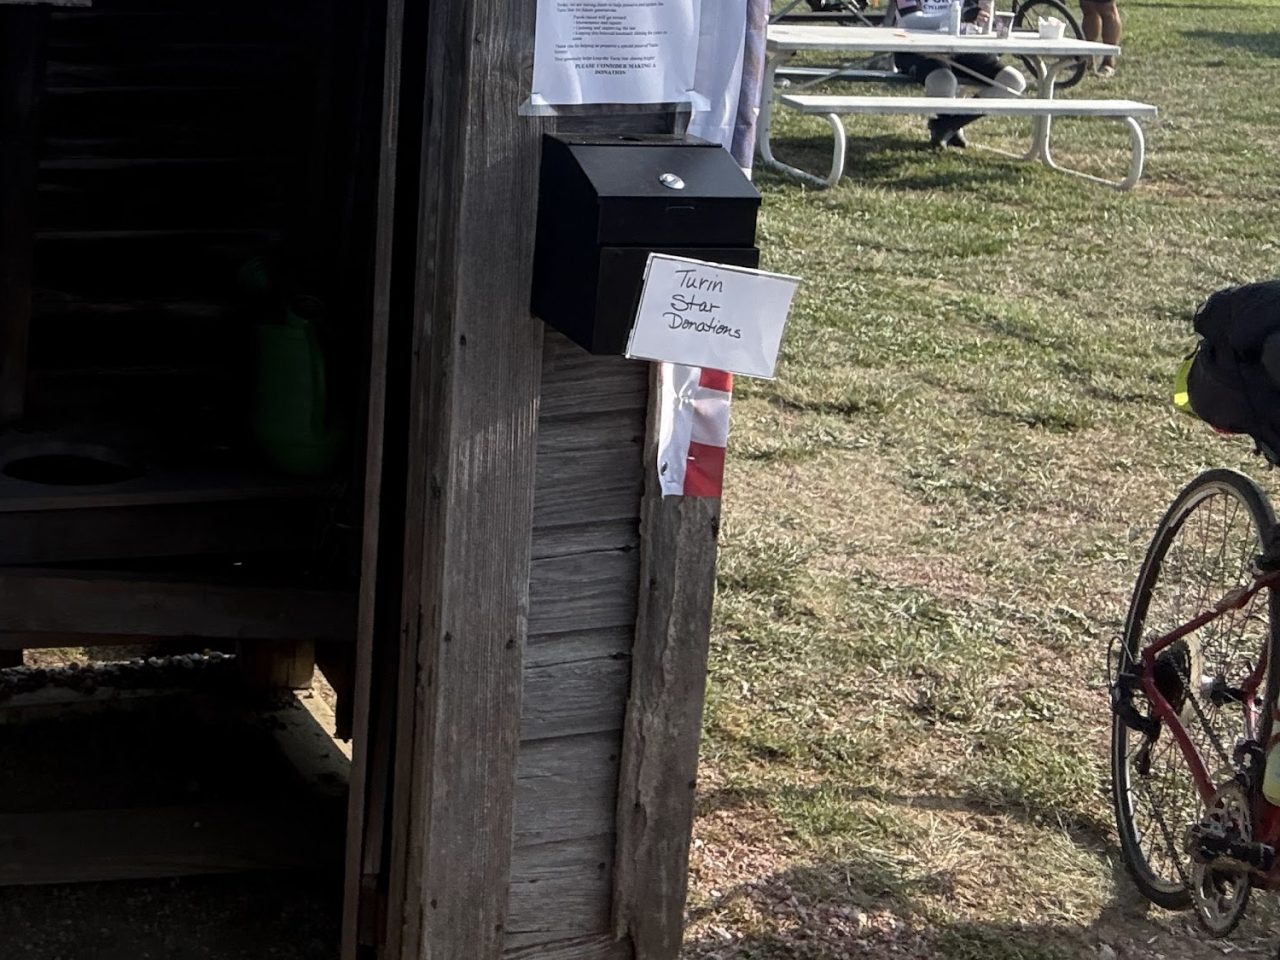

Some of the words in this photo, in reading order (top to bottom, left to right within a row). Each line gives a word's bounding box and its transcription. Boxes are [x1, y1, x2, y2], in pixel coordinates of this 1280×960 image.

[675, 269, 723, 292] Turin
[670, 294, 720, 312] Star
[662, 312, 742, 339] Donations
